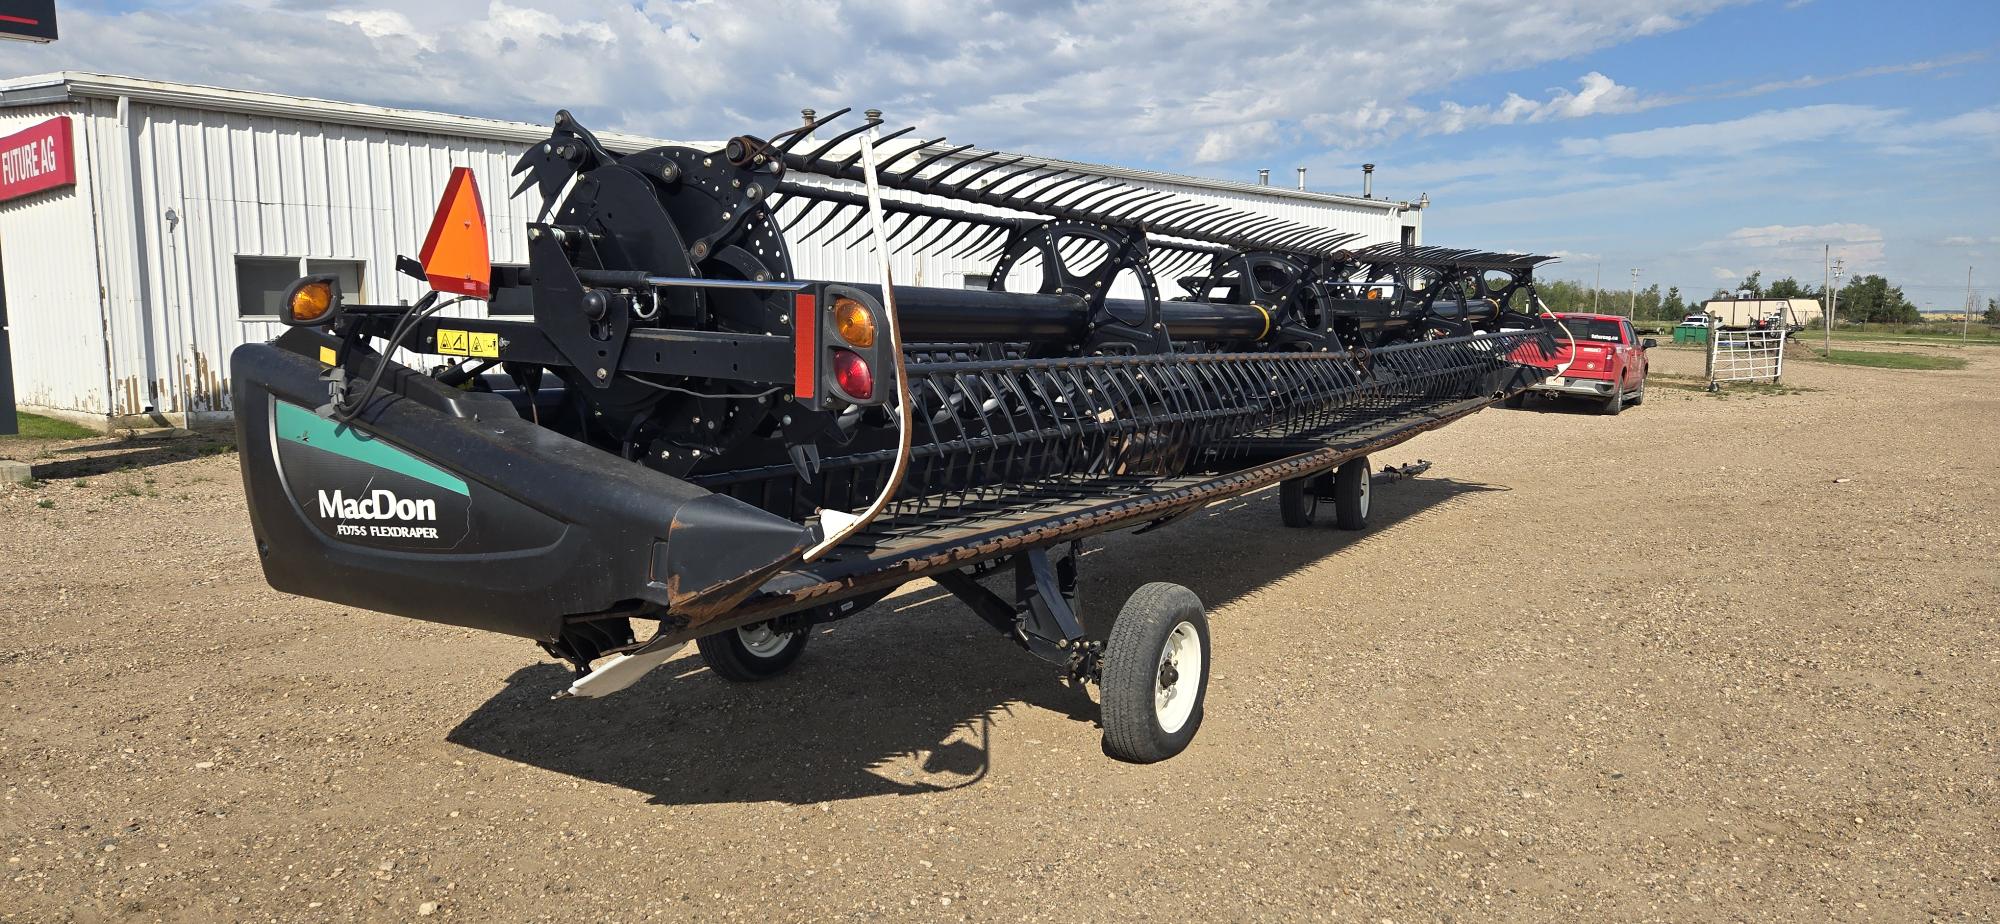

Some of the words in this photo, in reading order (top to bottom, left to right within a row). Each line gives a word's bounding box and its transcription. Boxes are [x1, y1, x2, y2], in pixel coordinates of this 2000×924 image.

[1, 141, 40, 185] FUTURE
[40, 135, 56, 174] AG
[318, 489, 436, 520] MacDon
[337, 525, 367, 536] FD75-S
[370, 526, 439, 538] FLEXDRAPER
